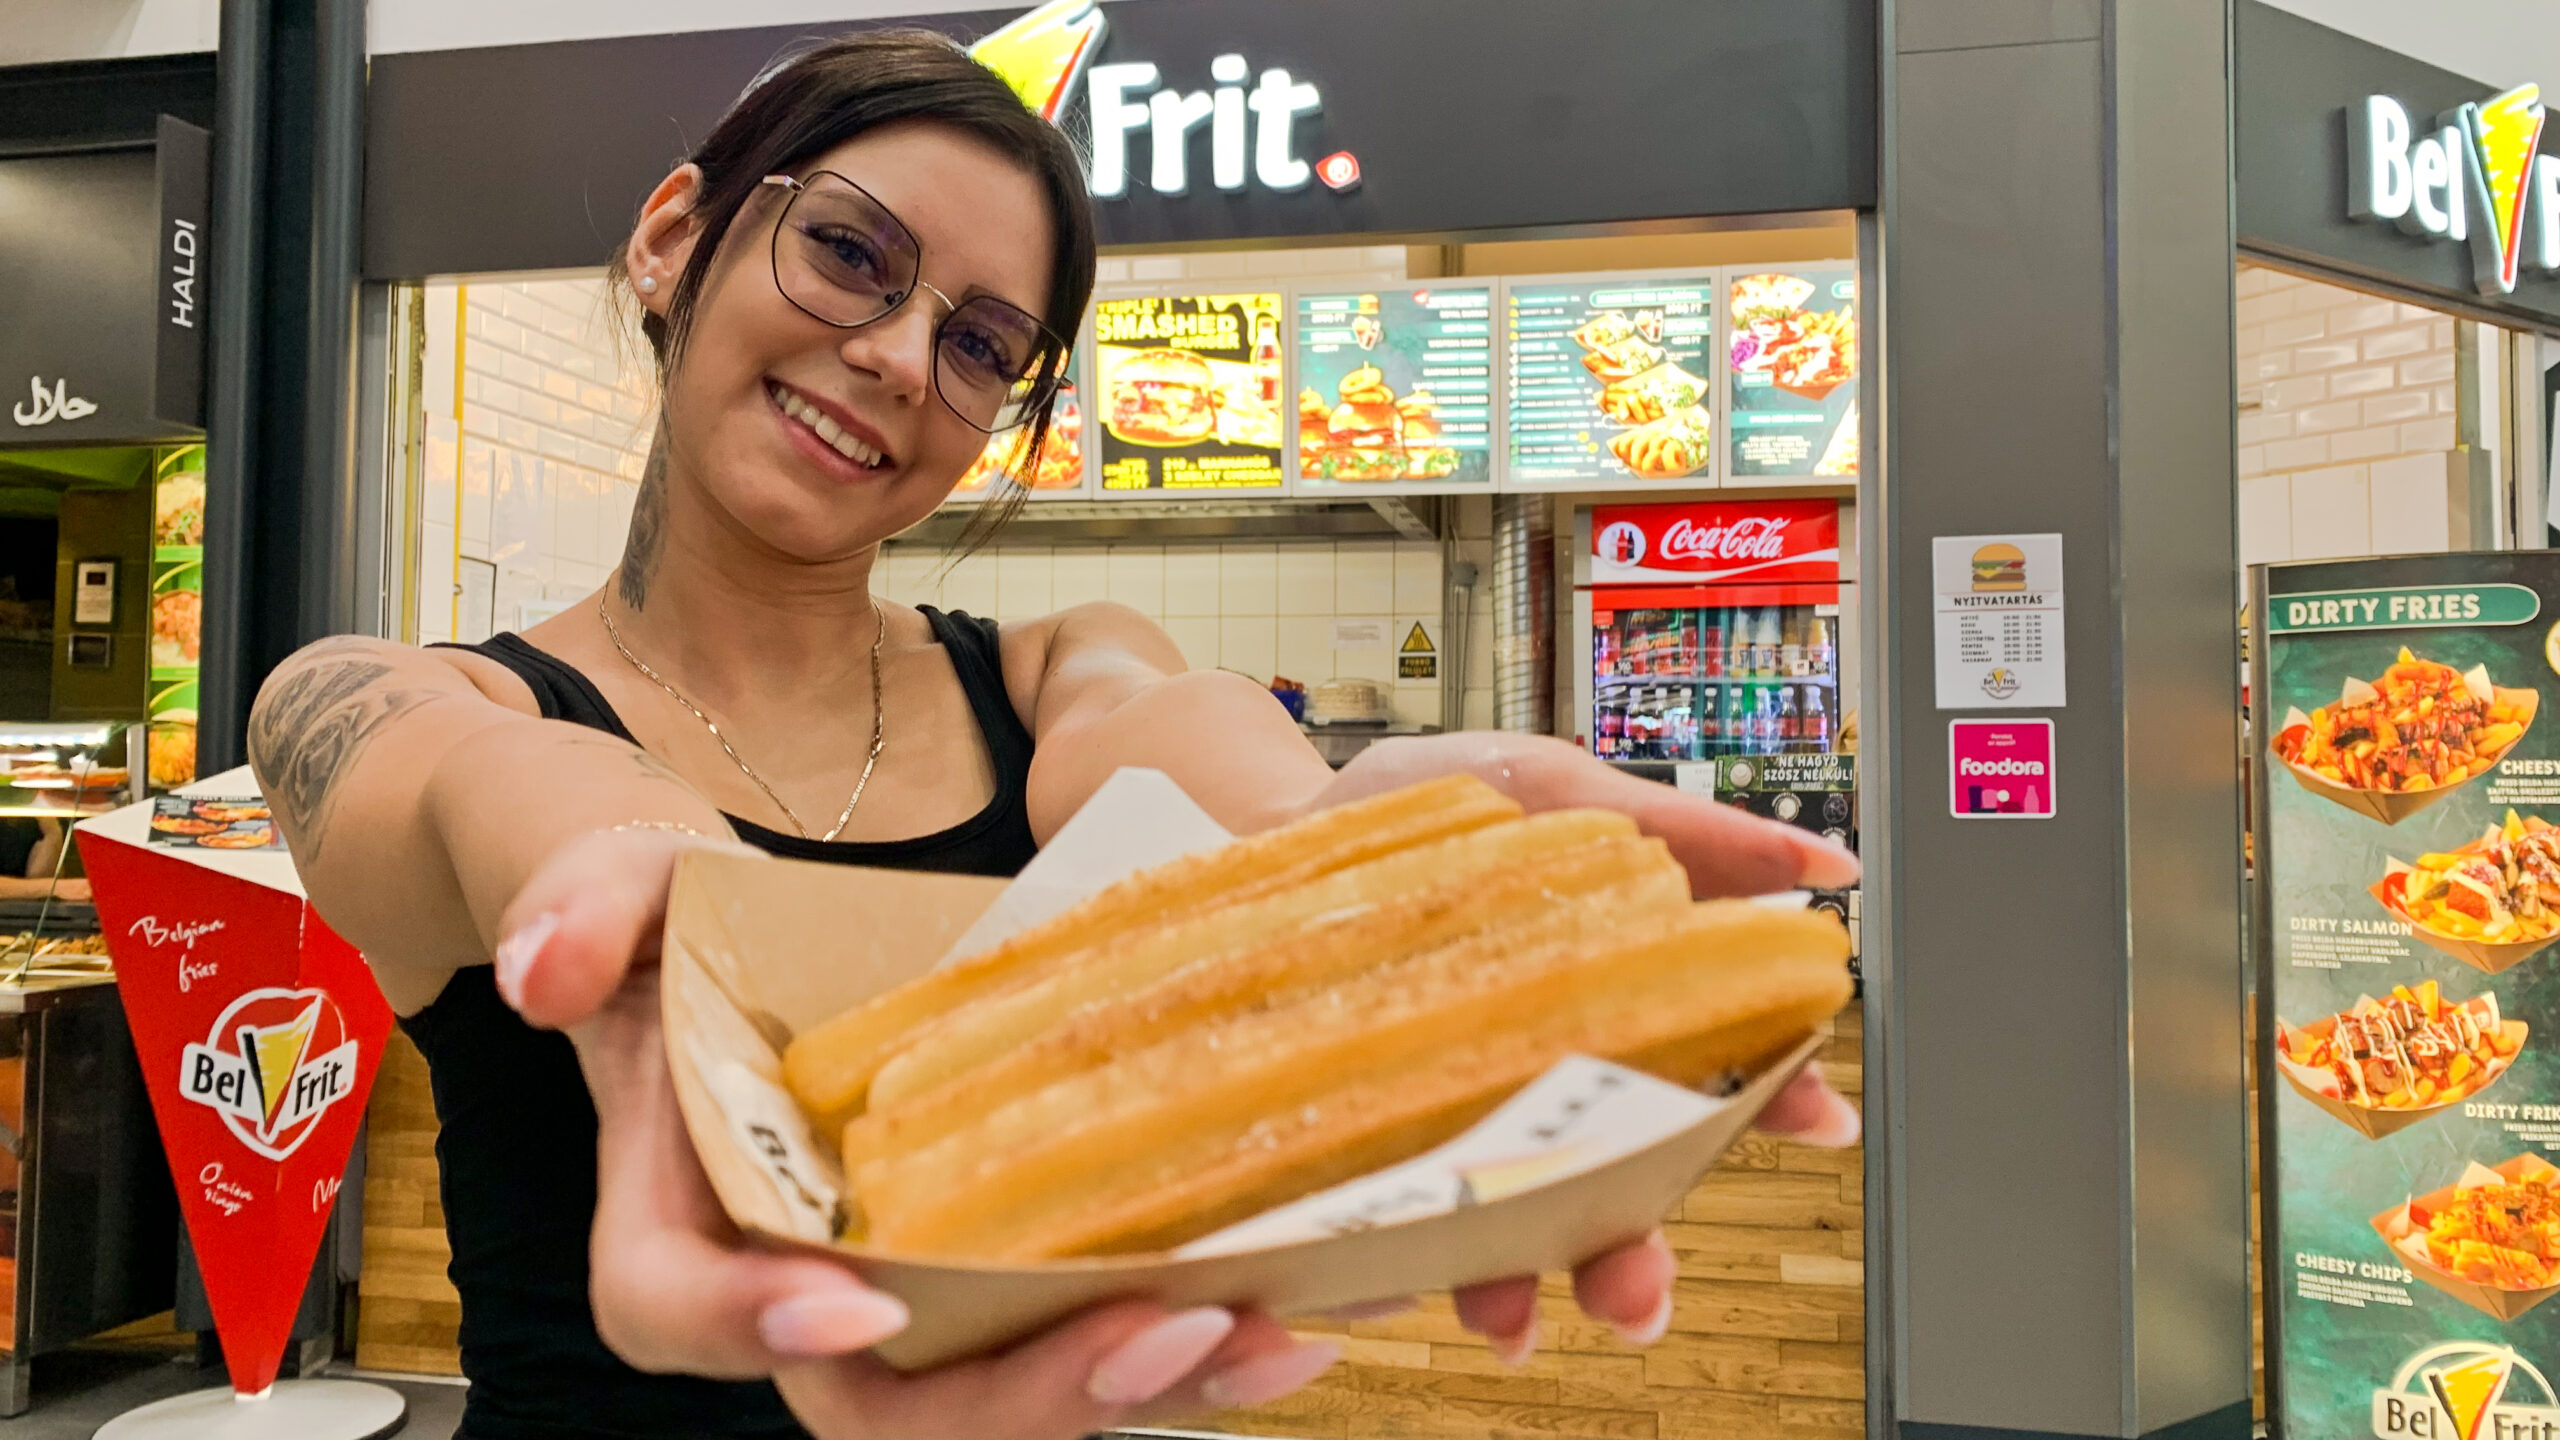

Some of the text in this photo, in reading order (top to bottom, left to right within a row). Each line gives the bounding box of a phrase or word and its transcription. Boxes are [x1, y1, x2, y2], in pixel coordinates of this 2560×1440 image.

[2367, 93, 2467, 242] Bel
[171, 218, 197, 329] HALDI
[1096, 312, 1239, 342] SMASHED
[1954, 594, 2043, 607] NYITVATARTÁS
[2288, 593, 2481, 626] DIRTY FRIES
[1764, 768, 1800, 781] SZÓSZ
[1779, 755, 1839, 767] NE HAGYD
[1960, 757, 2045, 776] foodora
[2501, 759, 2560, 776] CHEESY
[128, 916, 226, 949] Belgian
[2290, 917, 2413, 936] DIRTY SALMON
[179, 953, 218, 992] fries
[192, 1053, 245, 1107] Bel
[2465, 1102, 2519, 1120] DIRTY
[199, 1162, 254, 1201] Onion
[2296, 1252, 2413, 1284] CHEESY CHIPS
[2387, 1398, 2438, 1440] Bel
